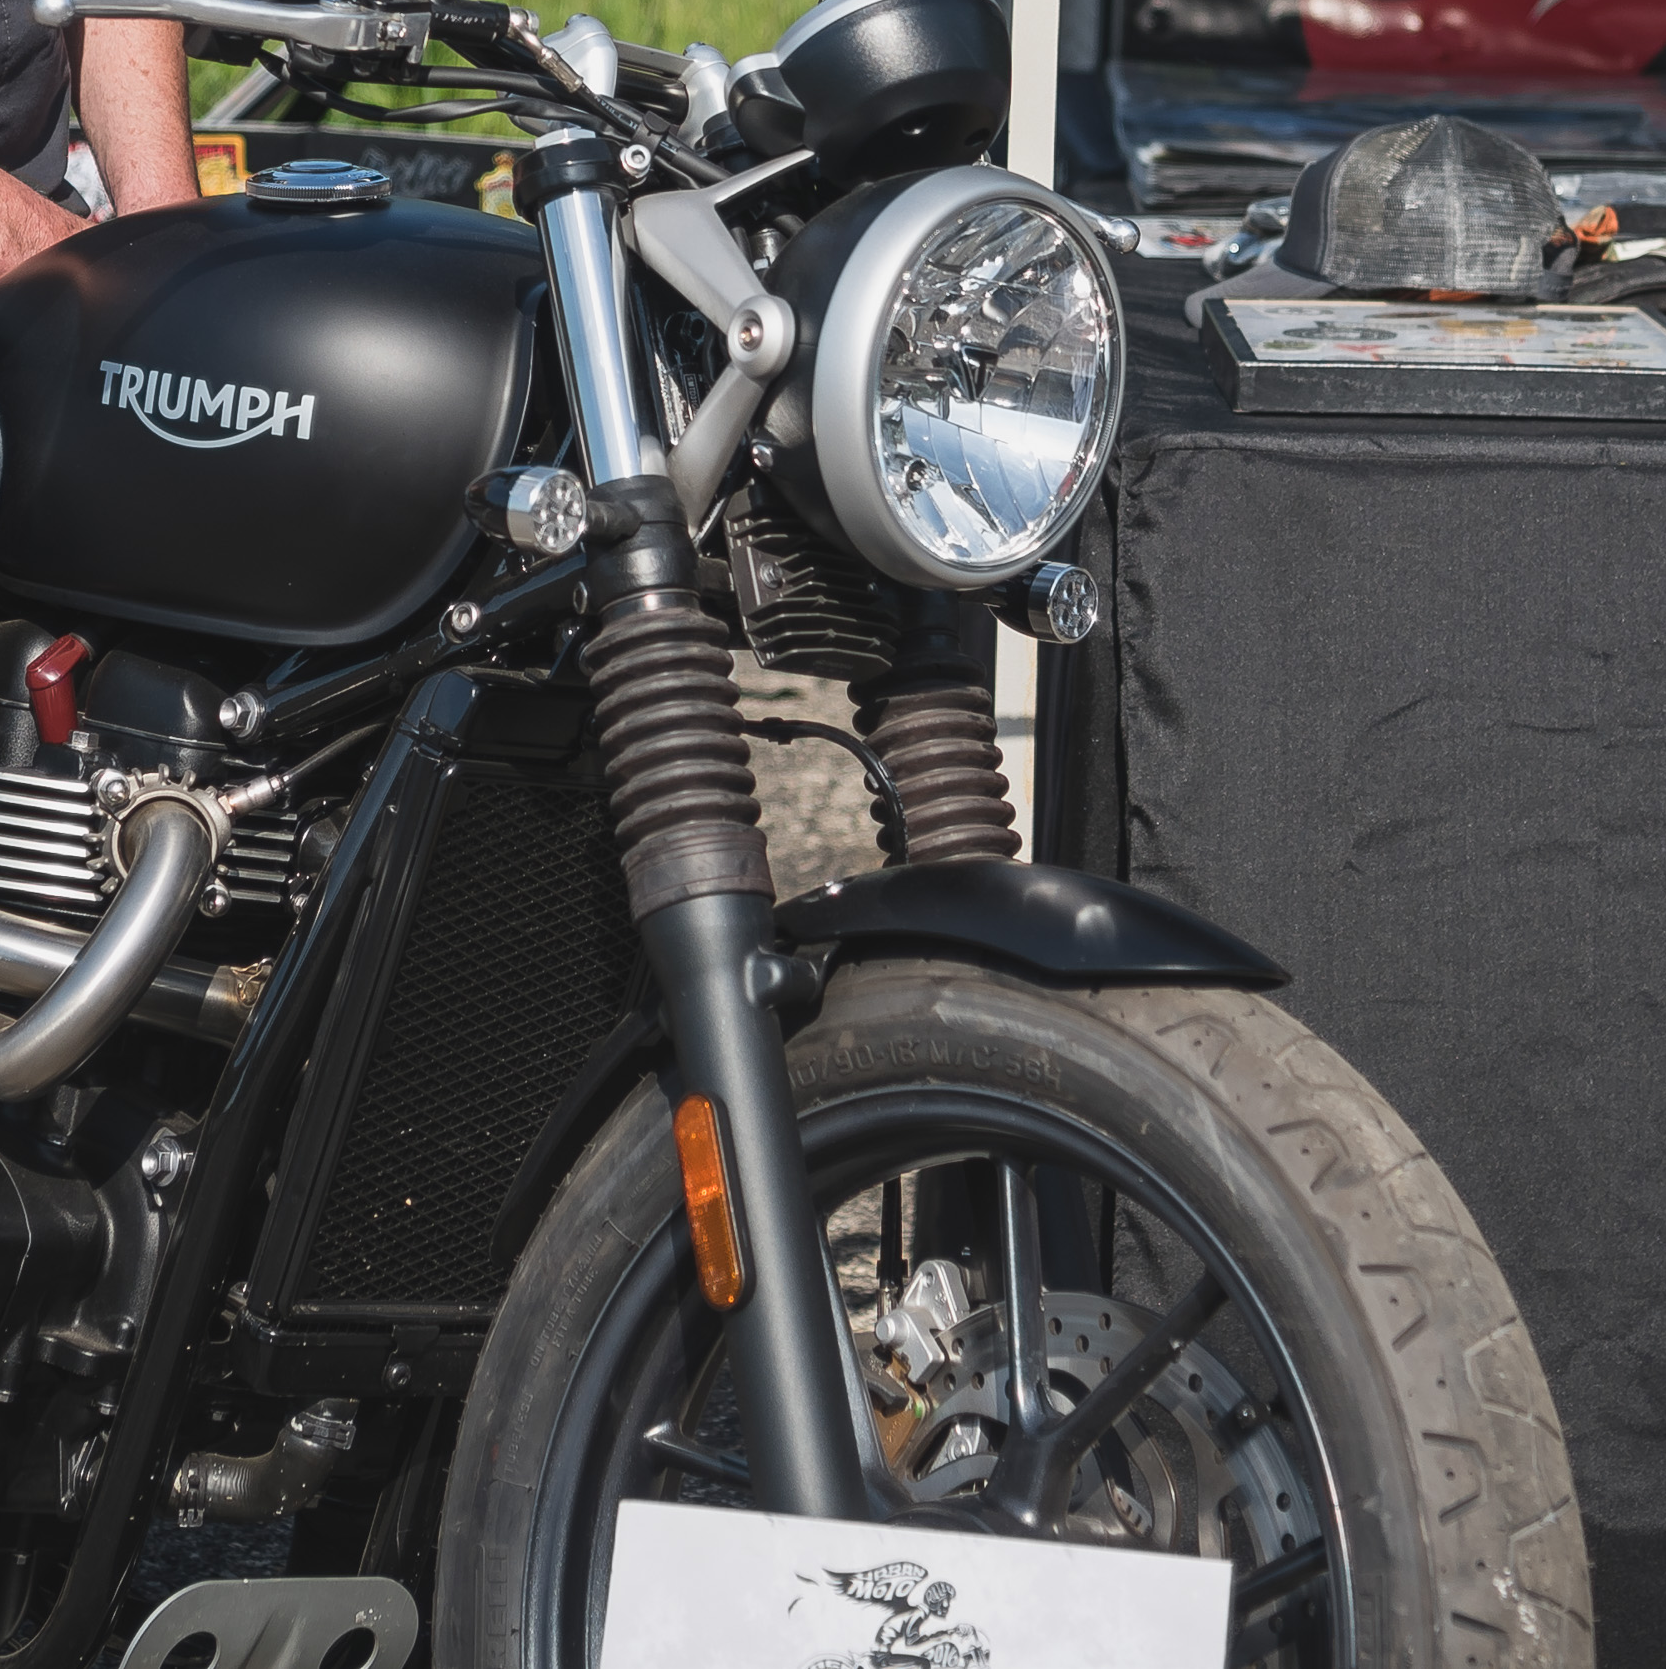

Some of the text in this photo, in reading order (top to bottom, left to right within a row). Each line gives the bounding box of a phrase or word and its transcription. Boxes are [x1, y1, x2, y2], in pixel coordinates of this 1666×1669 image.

[99, 360, 315, 449] TRIUMPH
[855, 1563, 926, 1580] URBAN
[847, 1580, 916, 1602] MOTO
